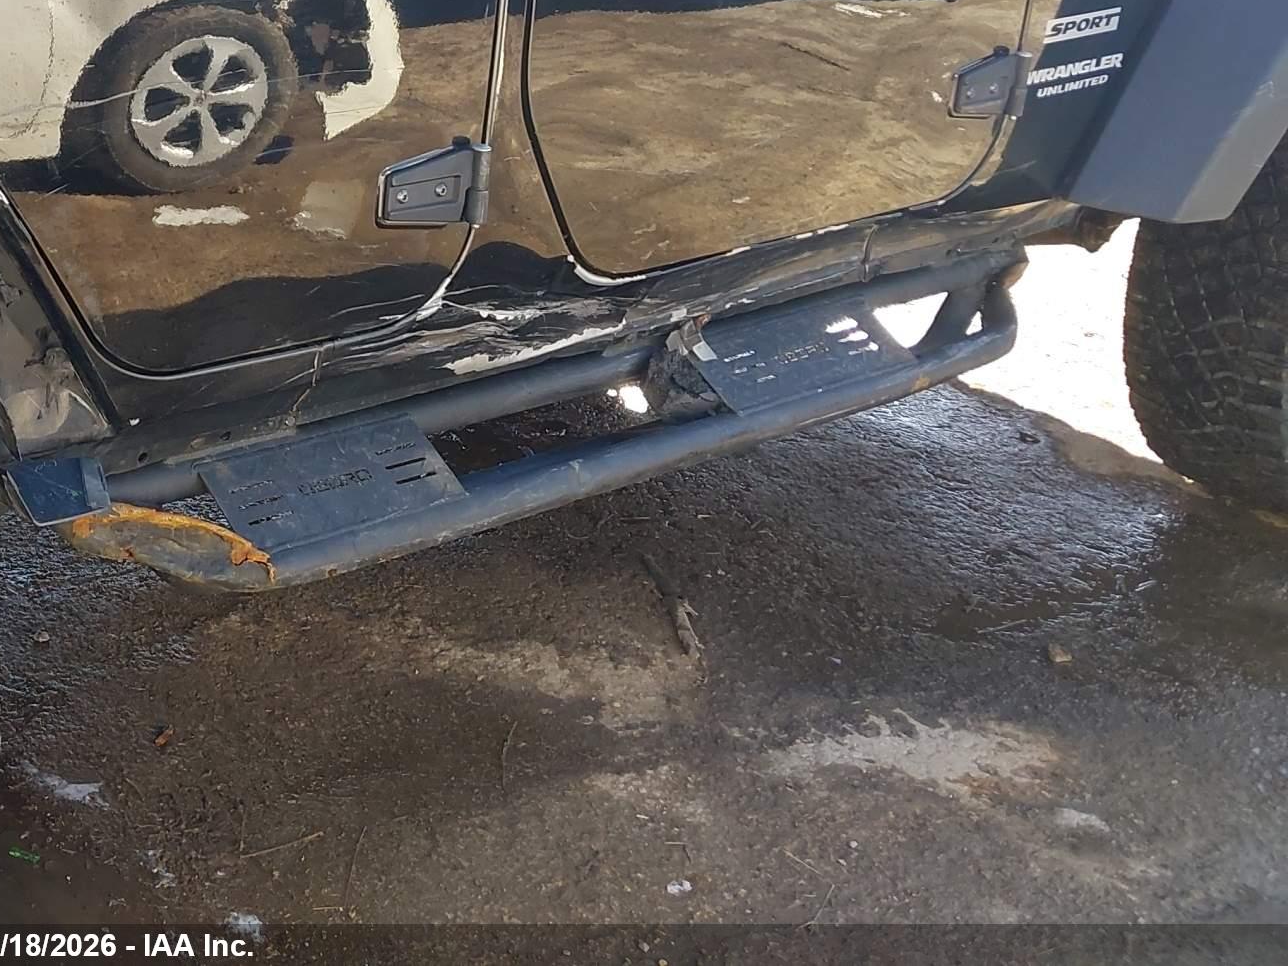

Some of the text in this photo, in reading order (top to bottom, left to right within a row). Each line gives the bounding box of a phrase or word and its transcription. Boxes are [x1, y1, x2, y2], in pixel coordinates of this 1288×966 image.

[1047, 13, 1114, 37] SPORT
[1027, 52, 1124, 85] WRANGLER
[1037, 74, 1109, 98] UNLIMITED
